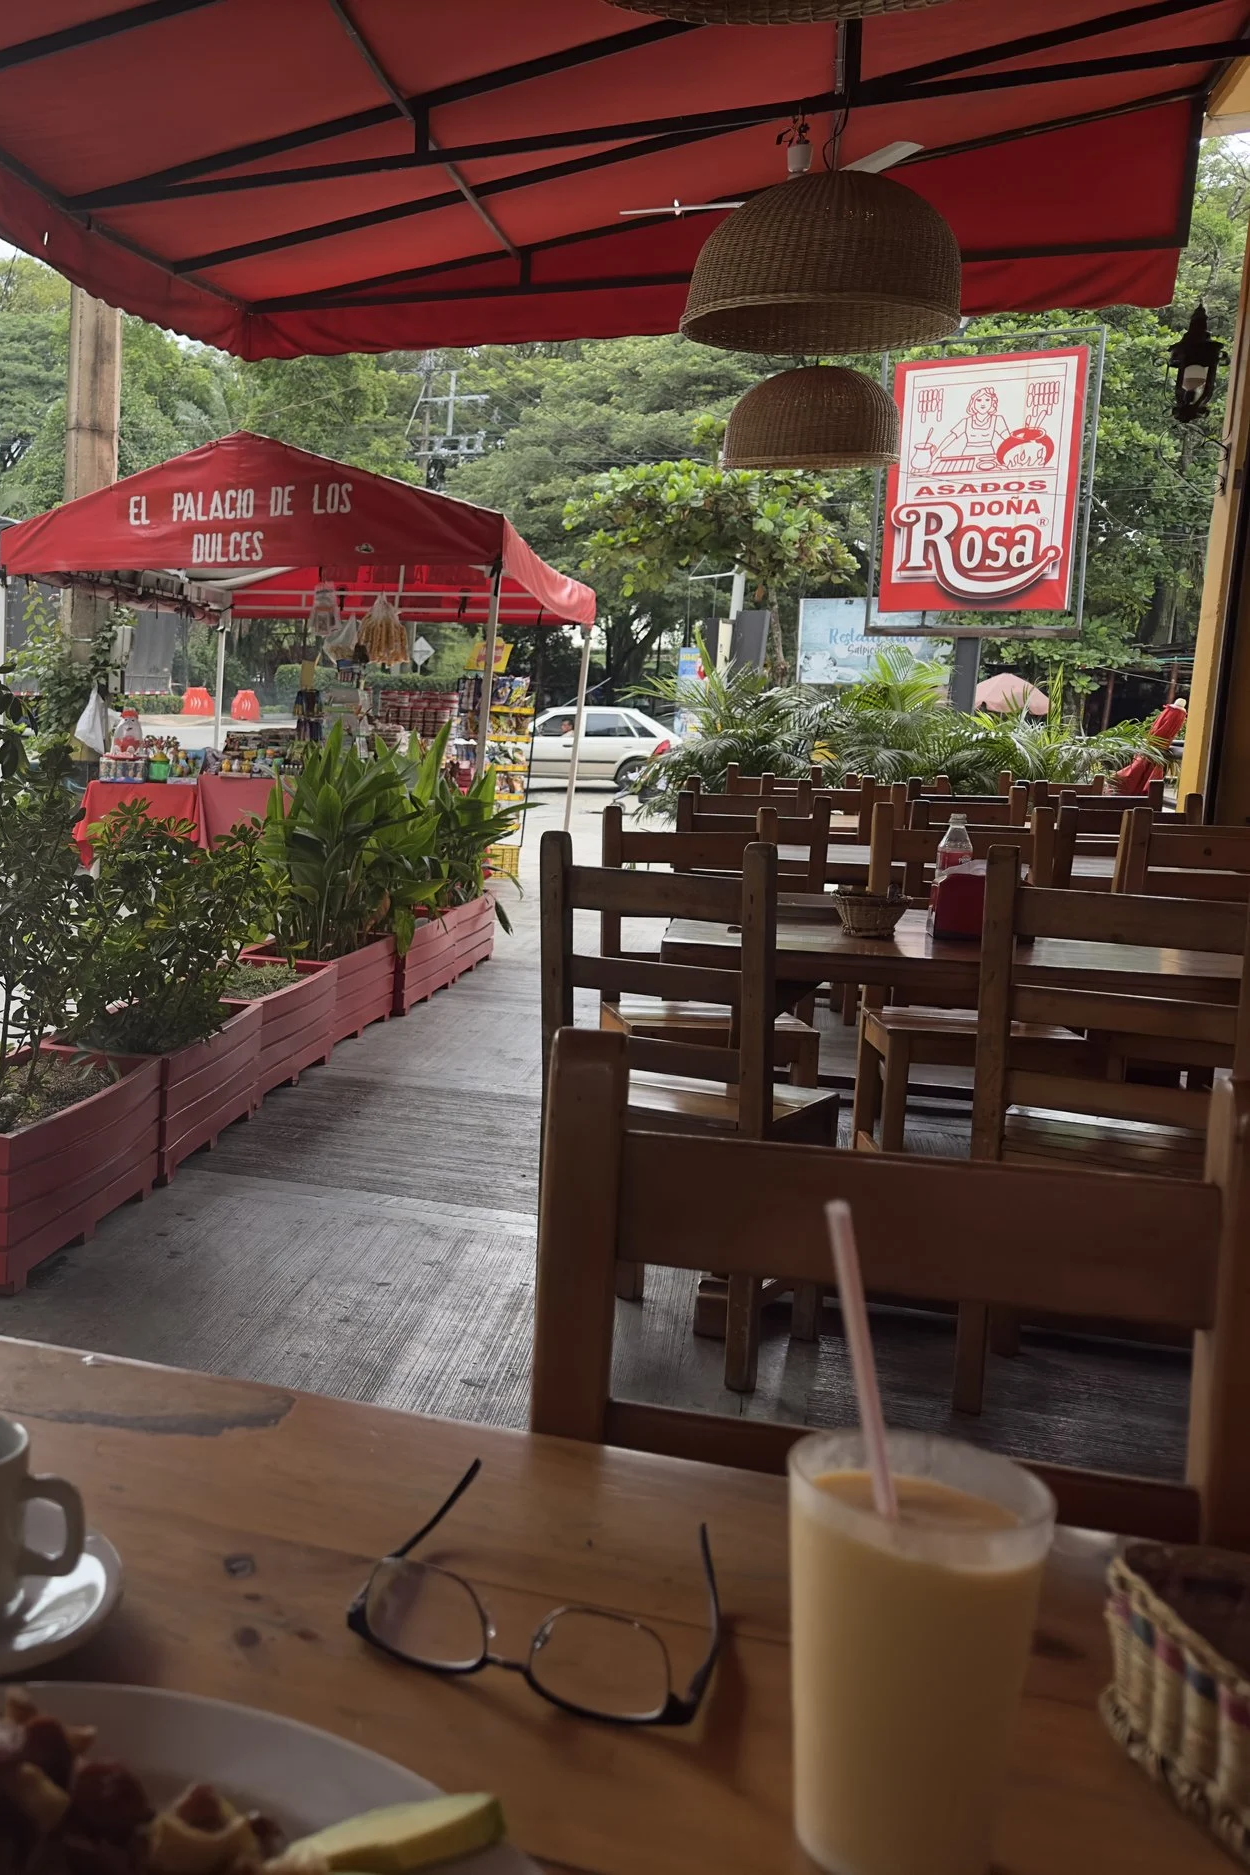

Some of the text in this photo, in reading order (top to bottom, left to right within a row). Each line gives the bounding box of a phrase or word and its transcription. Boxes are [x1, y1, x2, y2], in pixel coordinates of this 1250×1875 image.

[128, 483, 354, 526] EL PALACIO DE LOS
[914, 480, 1048, 497] ASADOS
[969, 496, 1042, 516] DOÑA
[191, 531, 264, 564] DULCES
[895, 503, 1060, 596] Rosa
